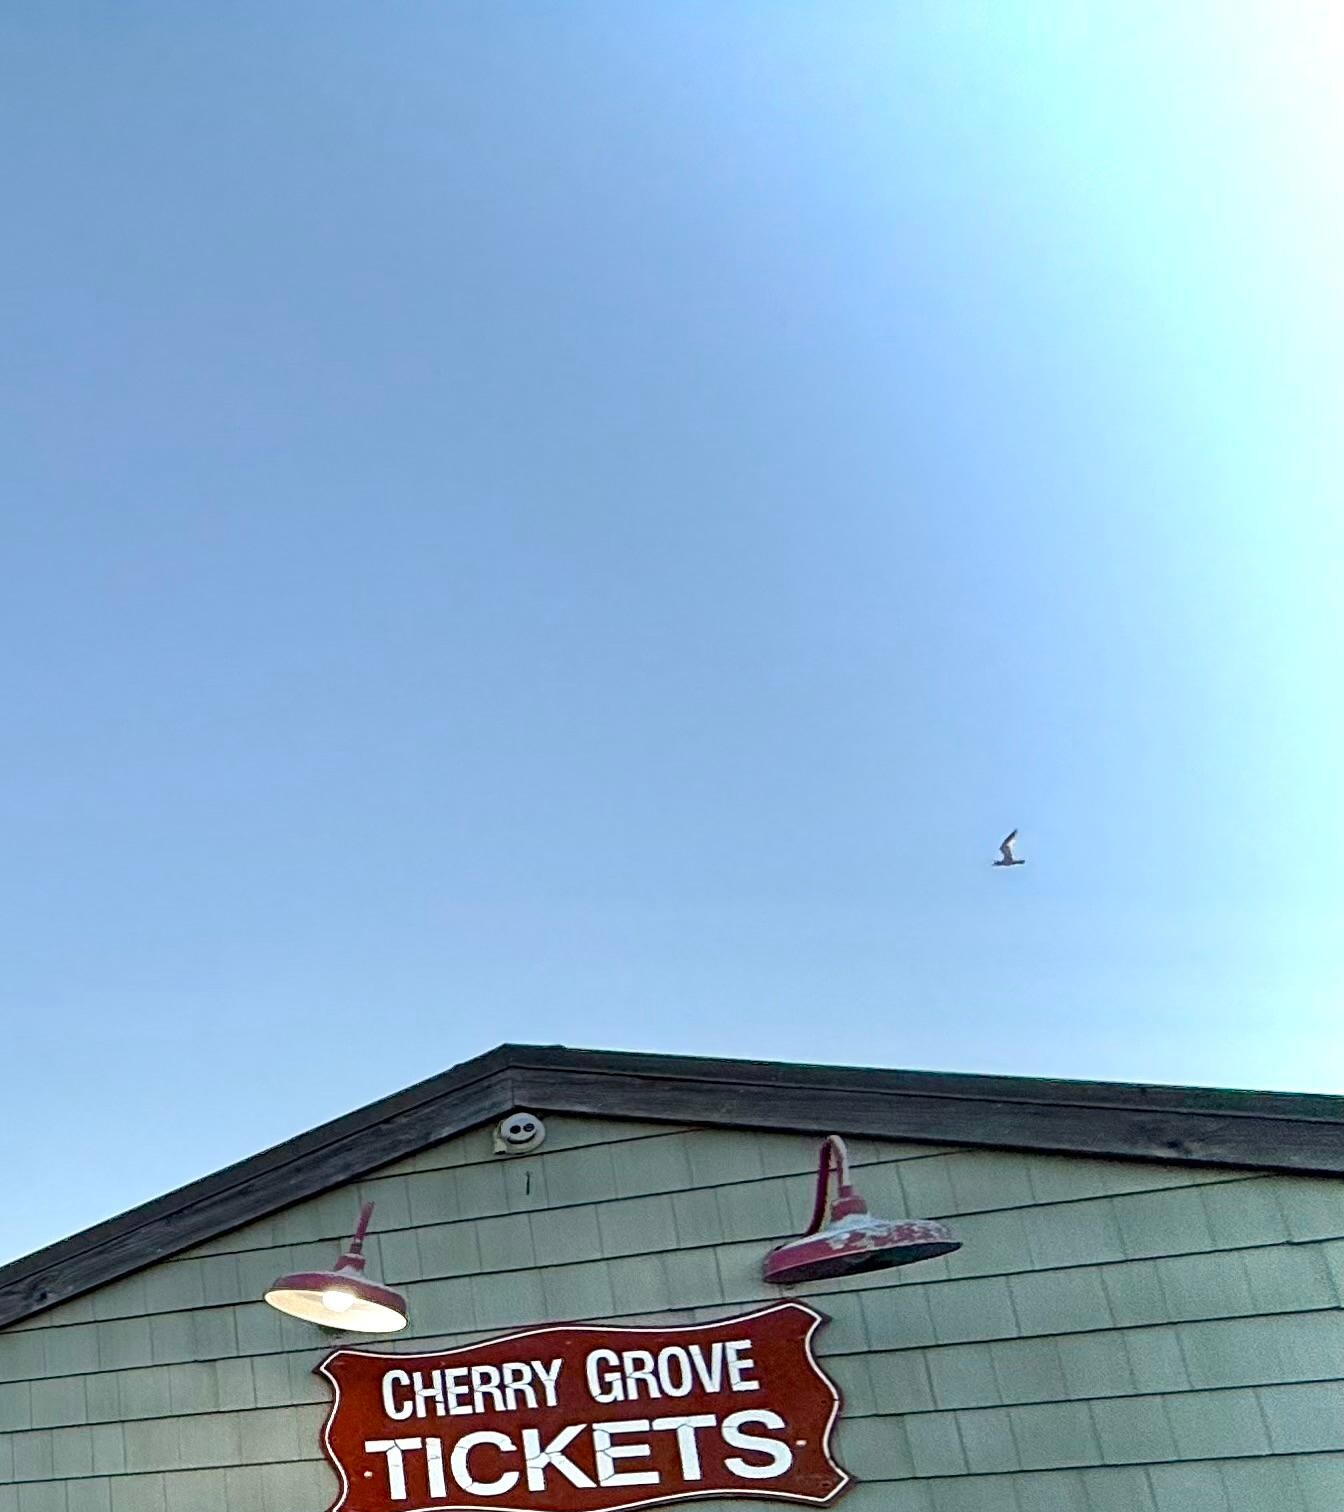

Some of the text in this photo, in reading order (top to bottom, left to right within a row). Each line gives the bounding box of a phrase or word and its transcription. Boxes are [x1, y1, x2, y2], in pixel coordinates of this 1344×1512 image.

[382, 1339, 760, 1421] CHERRY GROVE
[364, 1409, 795, 1502] TICKETS
